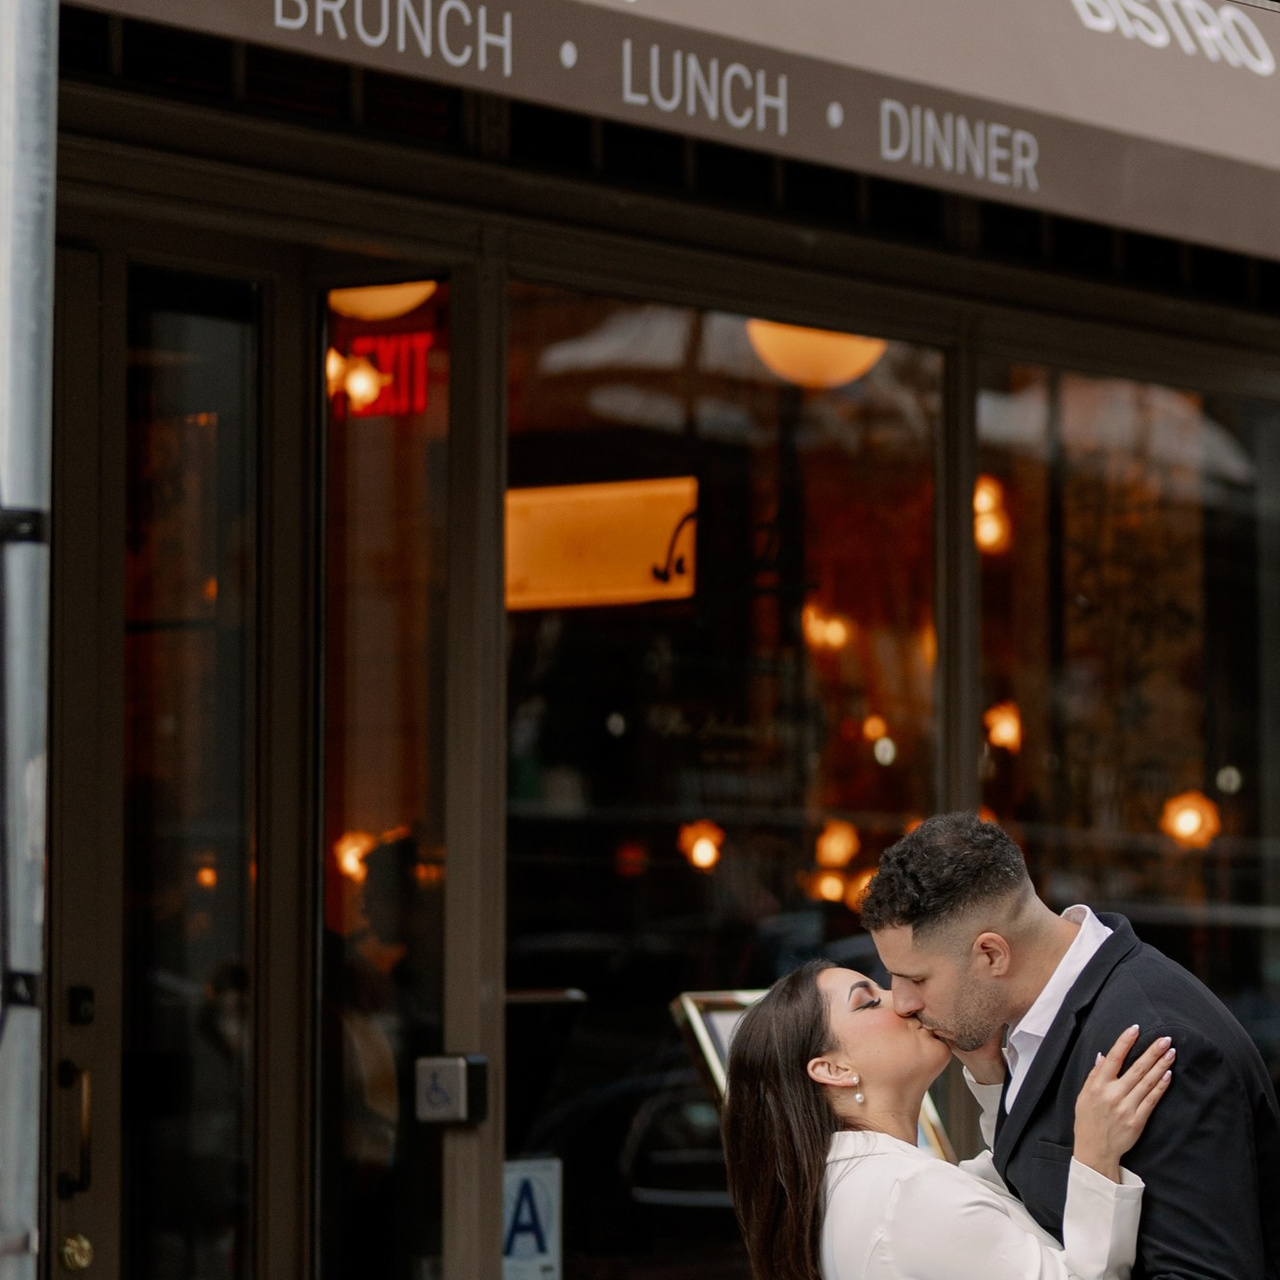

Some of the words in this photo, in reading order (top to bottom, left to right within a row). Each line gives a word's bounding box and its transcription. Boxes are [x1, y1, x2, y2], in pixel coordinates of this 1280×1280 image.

[622, 38, 789, 136] LUNCH
[880, 98, 1040, 193] DINNER
[502, 1177, 548, 1256] A
